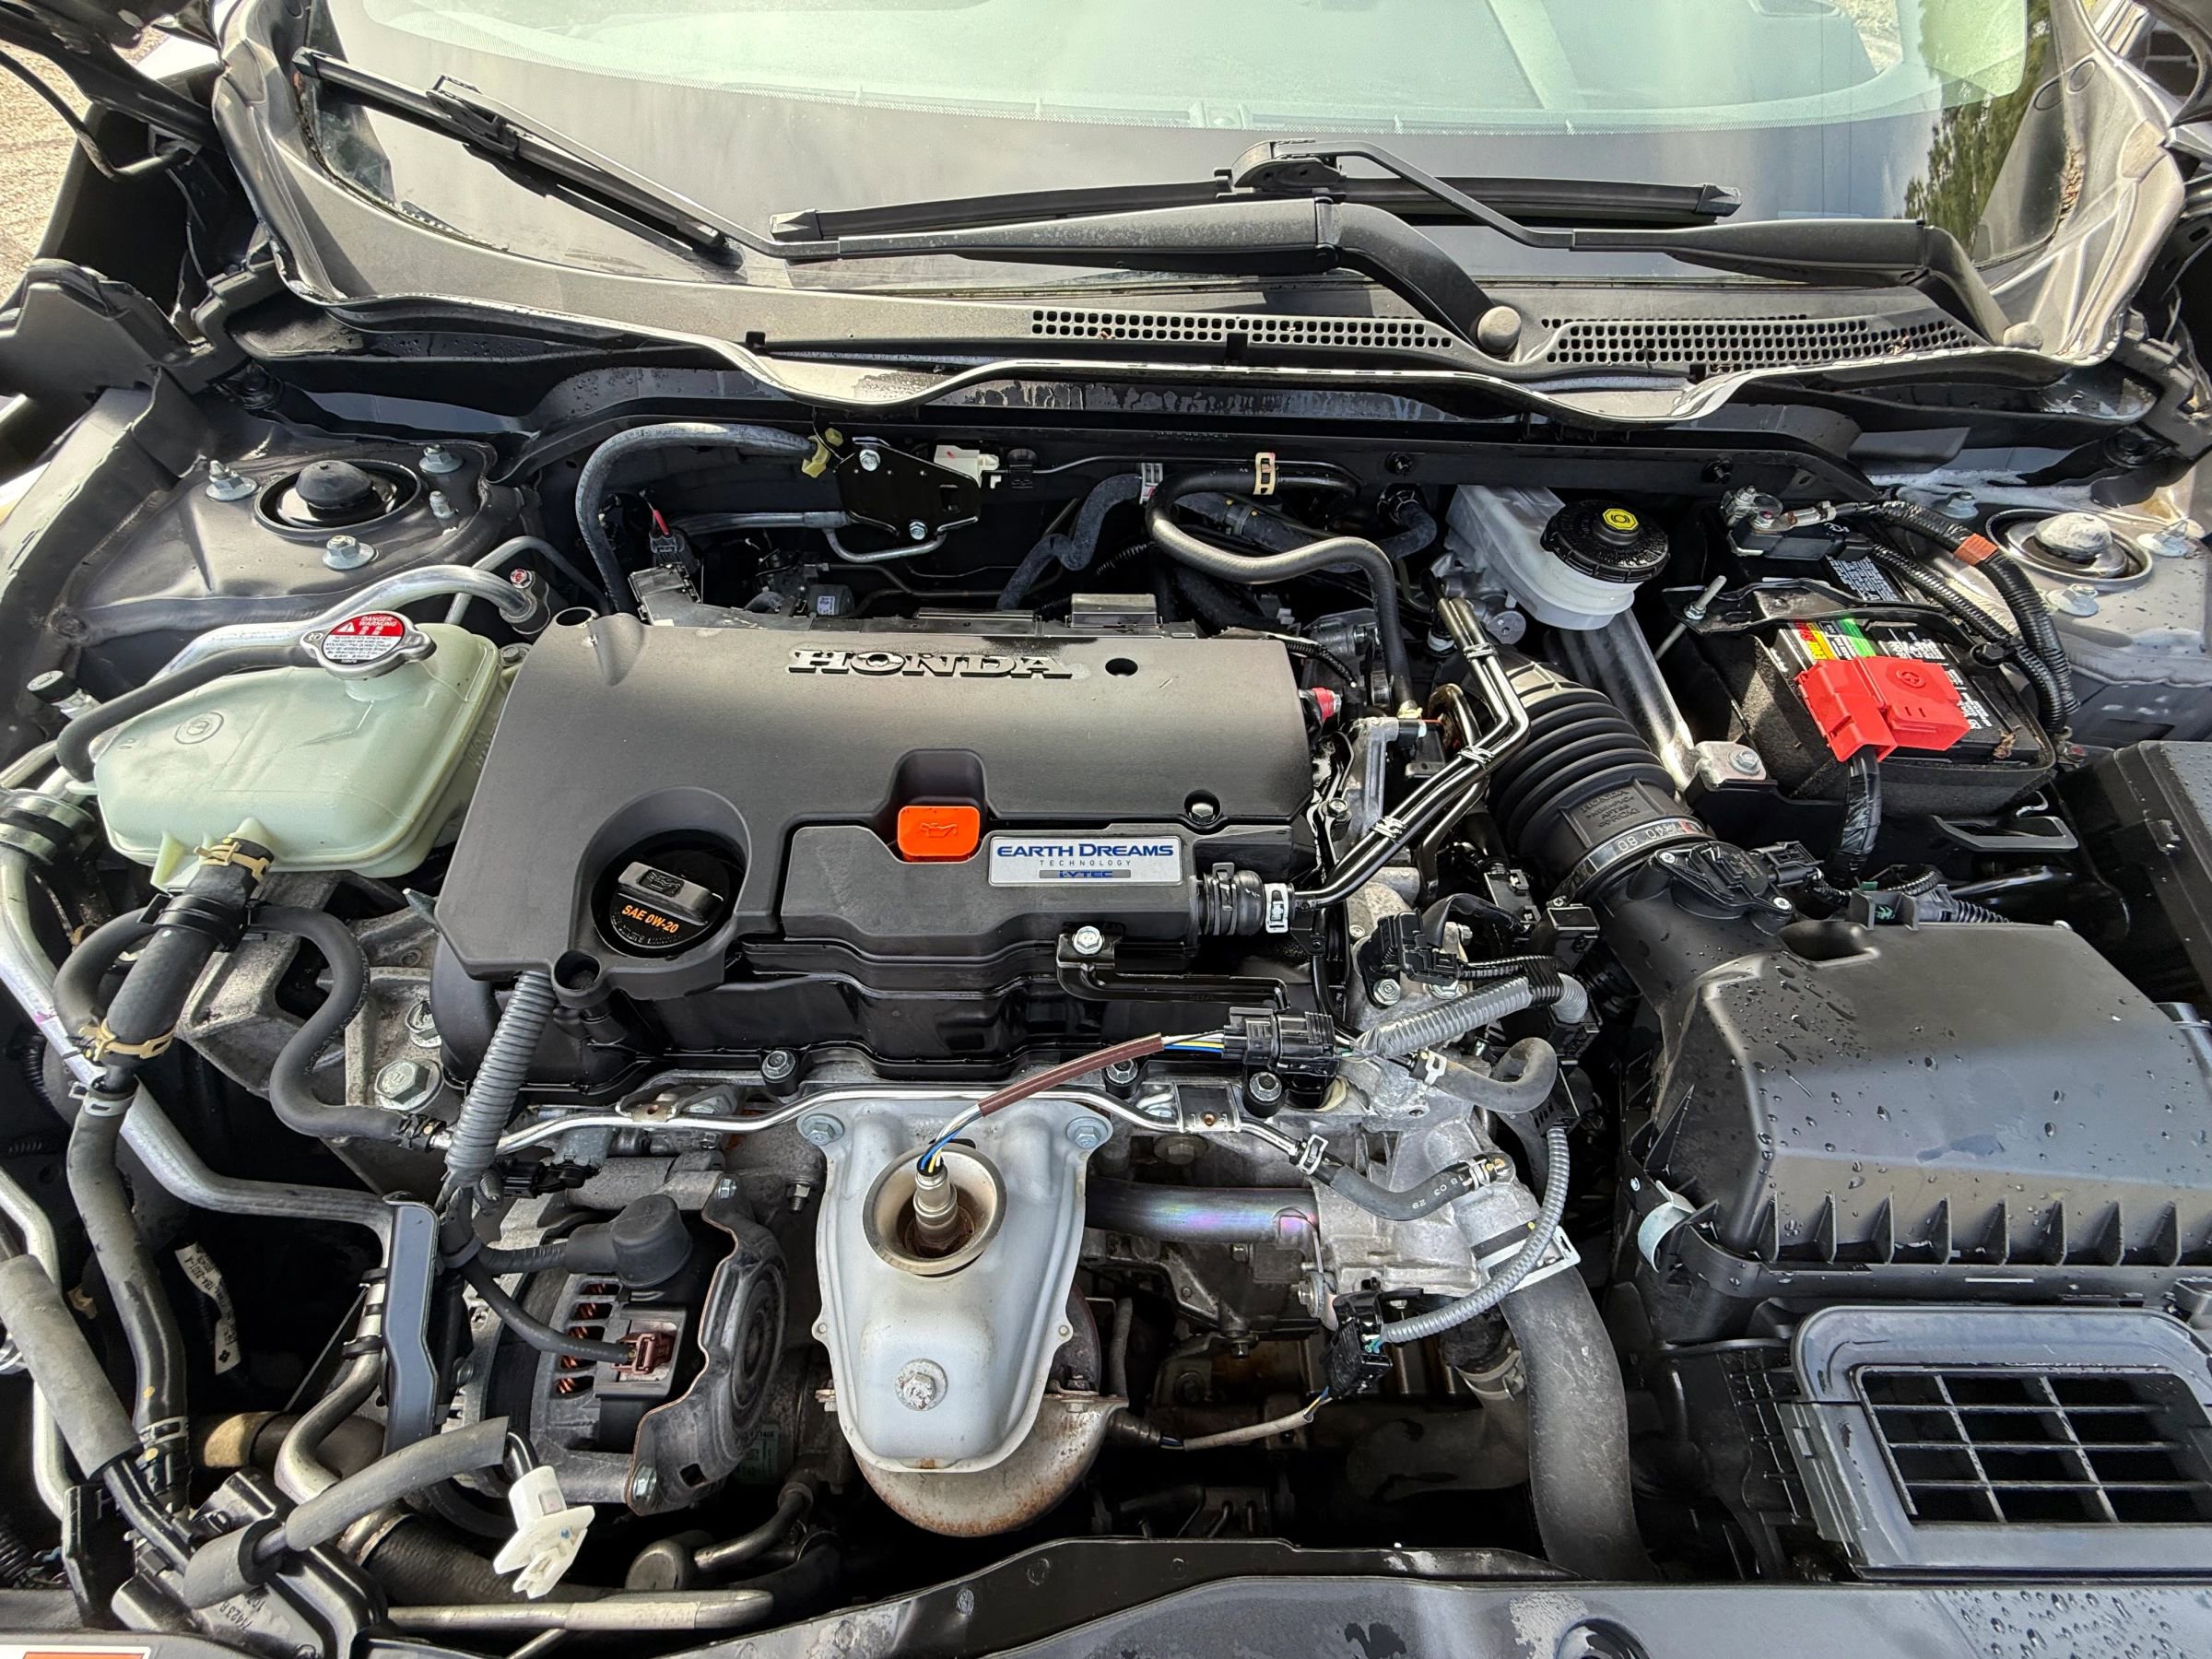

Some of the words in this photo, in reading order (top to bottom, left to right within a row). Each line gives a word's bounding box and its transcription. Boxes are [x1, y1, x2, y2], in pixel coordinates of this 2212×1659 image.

[788, 650, 1073, 679] HONDA
[997, 844, 1074, 857] EARTH
[1078, 843, 1174, 857] DREAMS
[1040, 859, 1132, 867] TECHNOLOGY
[621, 904, 648, 922] SAE
[644, 913, 680, 935] 0W-20
